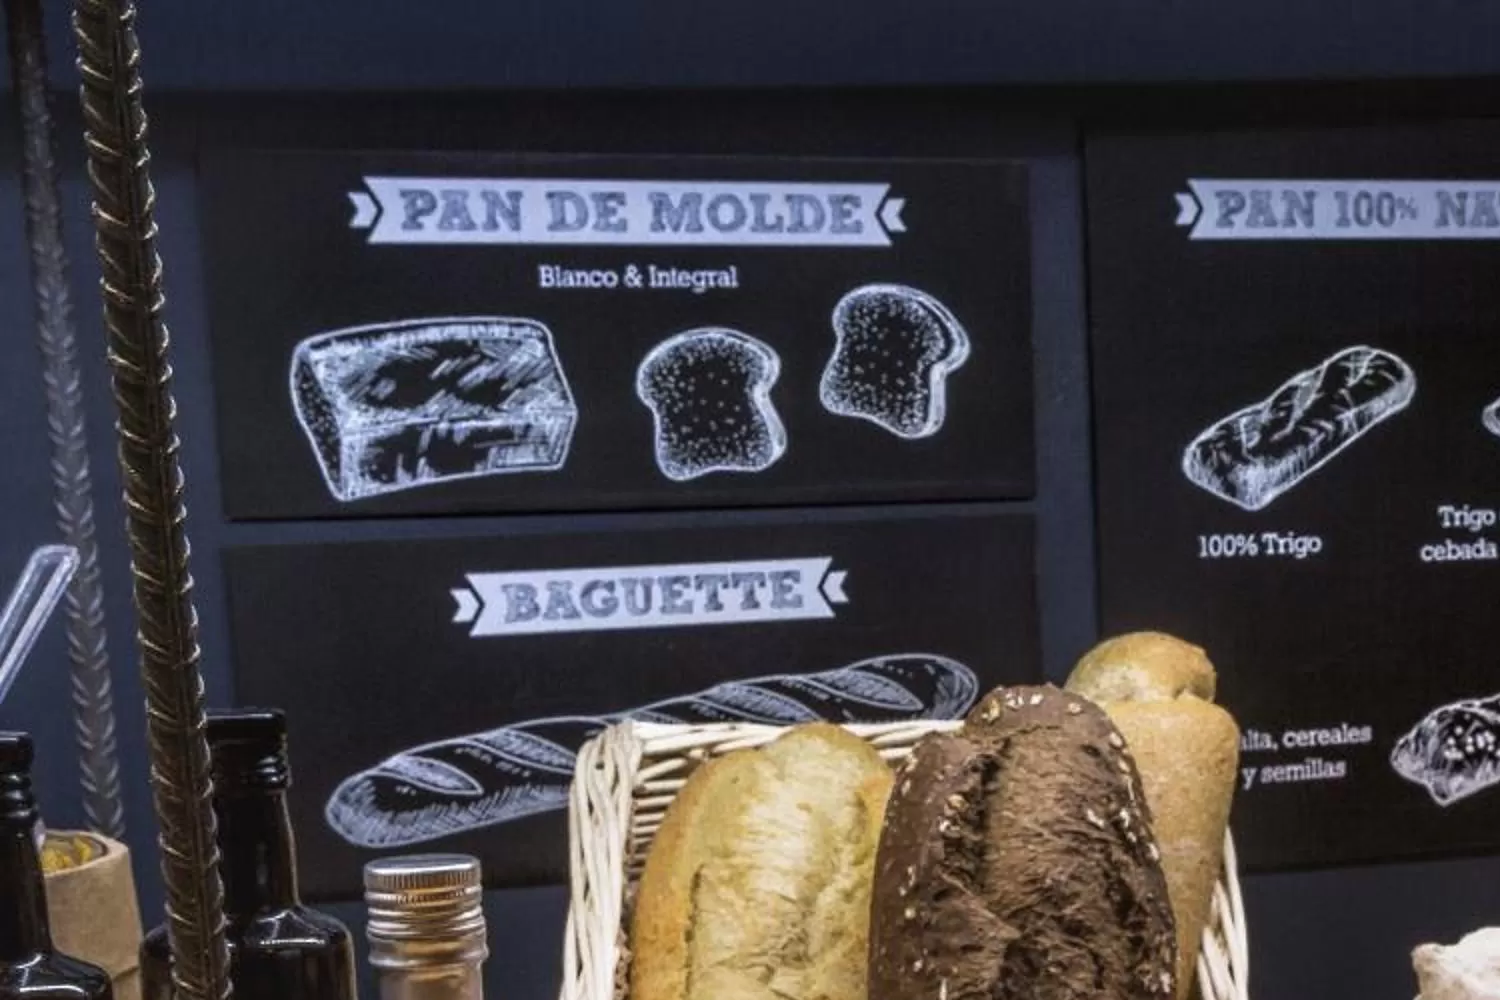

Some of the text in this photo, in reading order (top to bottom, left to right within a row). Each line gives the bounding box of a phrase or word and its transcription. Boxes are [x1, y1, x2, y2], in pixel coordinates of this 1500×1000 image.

[400, 189, 865, 234] PAN DE MOLDE
[1214, 190, 1318, 228] PAN
[1335, 190, 1419, 228] 100%
[538, 265, 738, 292] Blanco & Integral
[1437, 504, 1496, 532] Trigo
[1198, 531, 1323, 559] 100% Trigo
[1420, 537, 1497, 561] cebada
[502, 570, 804, 624] BAGUETTE
[1282, 722, 1373, 748] cereales
[1242, 757, 1346, 790] y semillas
